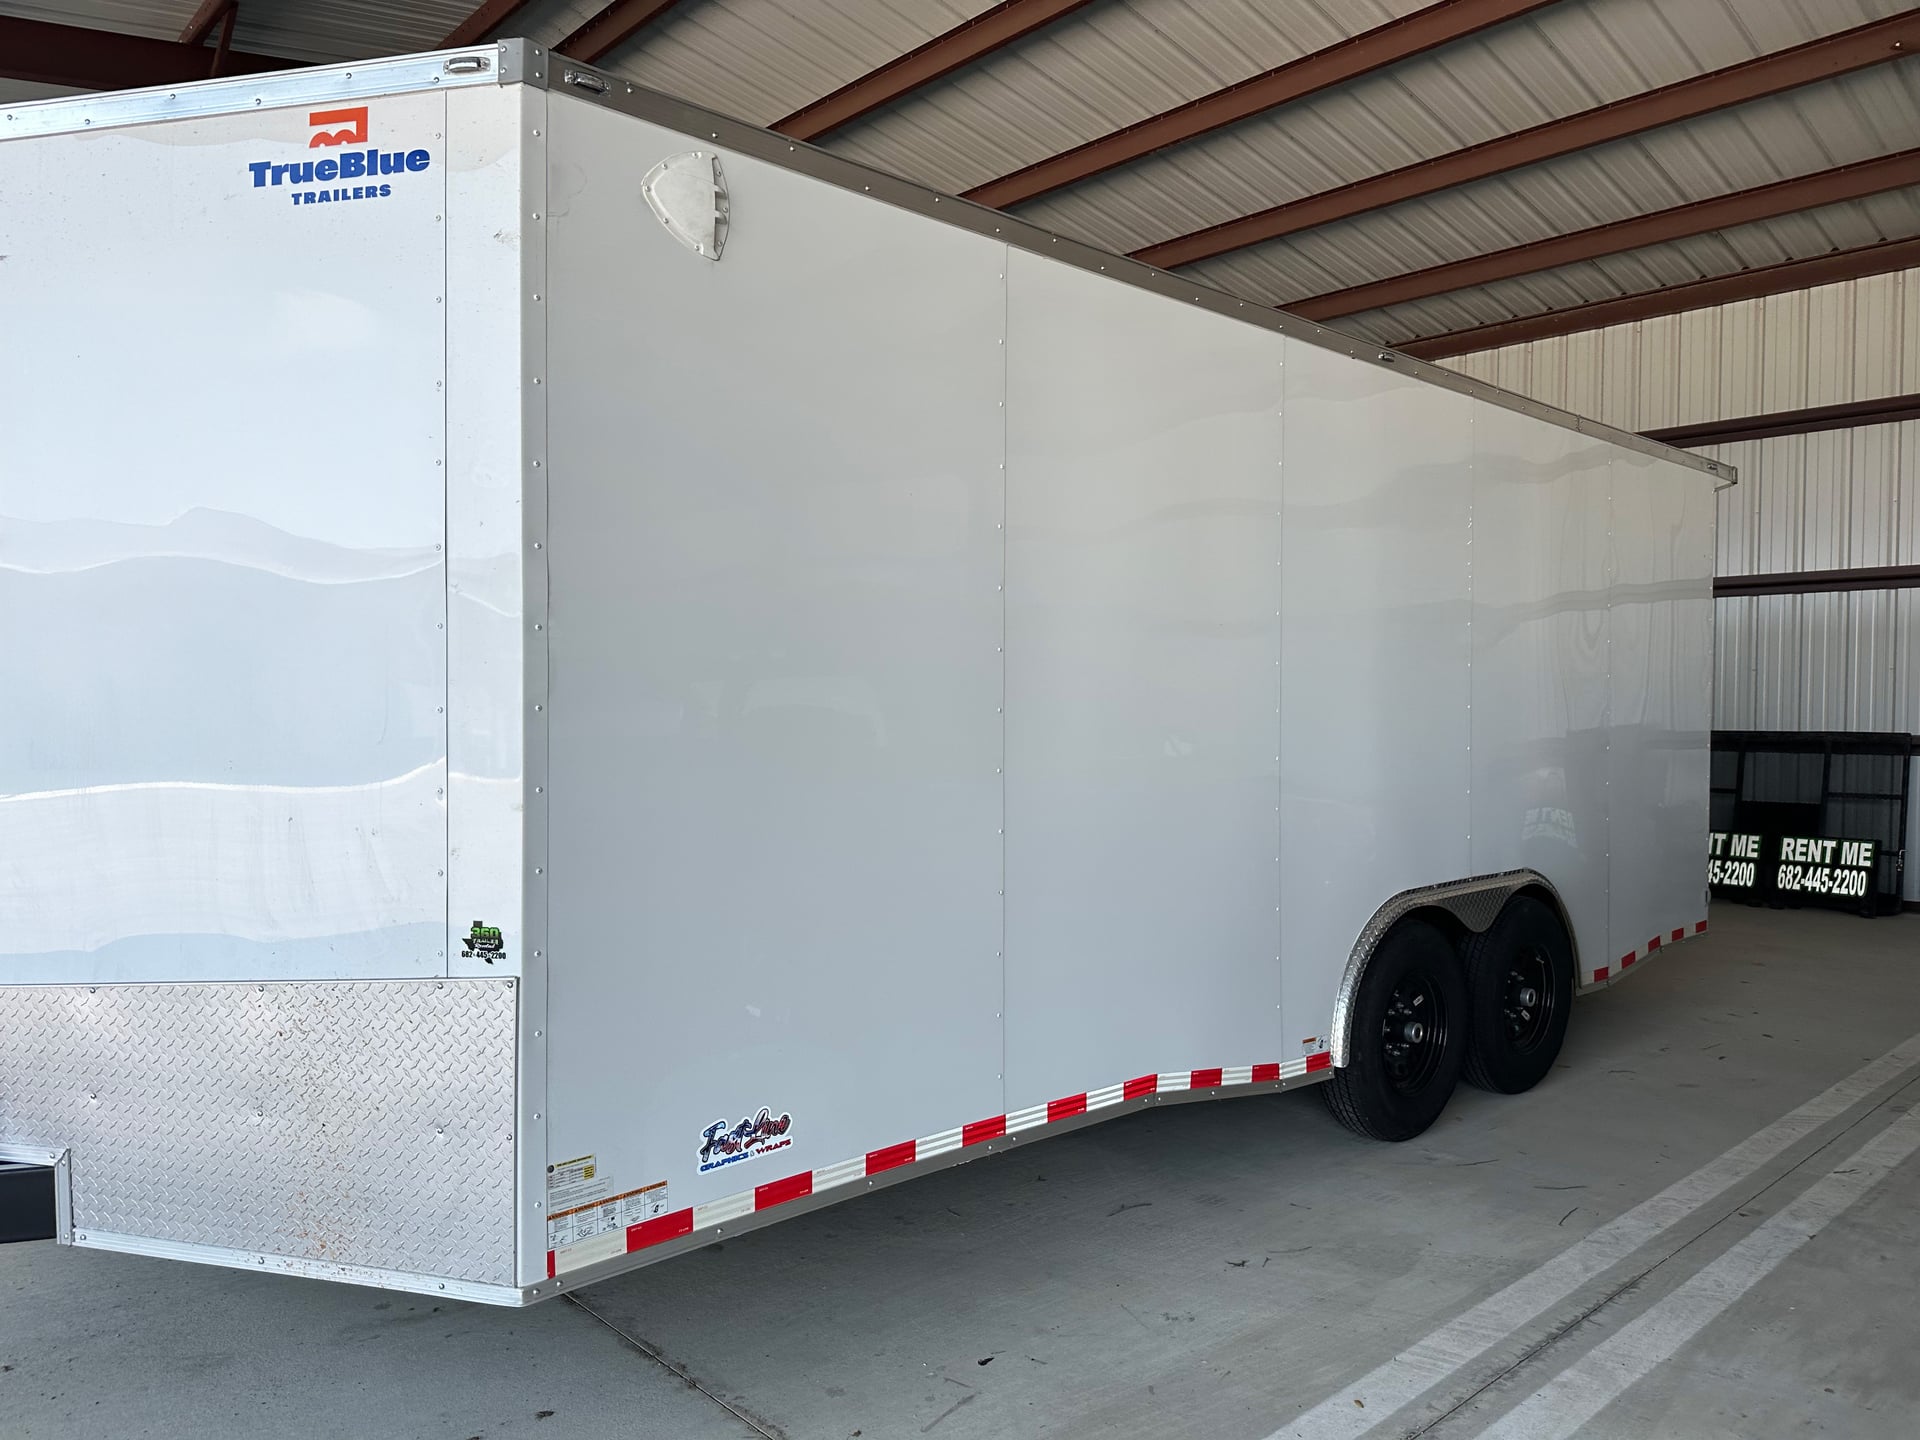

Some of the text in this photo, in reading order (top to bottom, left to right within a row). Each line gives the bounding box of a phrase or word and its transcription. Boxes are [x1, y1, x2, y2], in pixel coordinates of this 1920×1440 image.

[249, 149, 430, 188] TrueBlue
[292, 184, 391, 205] TRAILERS
[1731, 834, 1760, 858] ME
[1781, 838, 1873, 867] RENT ME
[1777, 864, 1866, 897] 682-445-2200
[471, 927, 500, 939] 360
[700, 1119, 752, 1163] Fast
[700, 1152, 749, 1172] GRAPHICS
[756, 1139, 792, 1154] WRAPS
